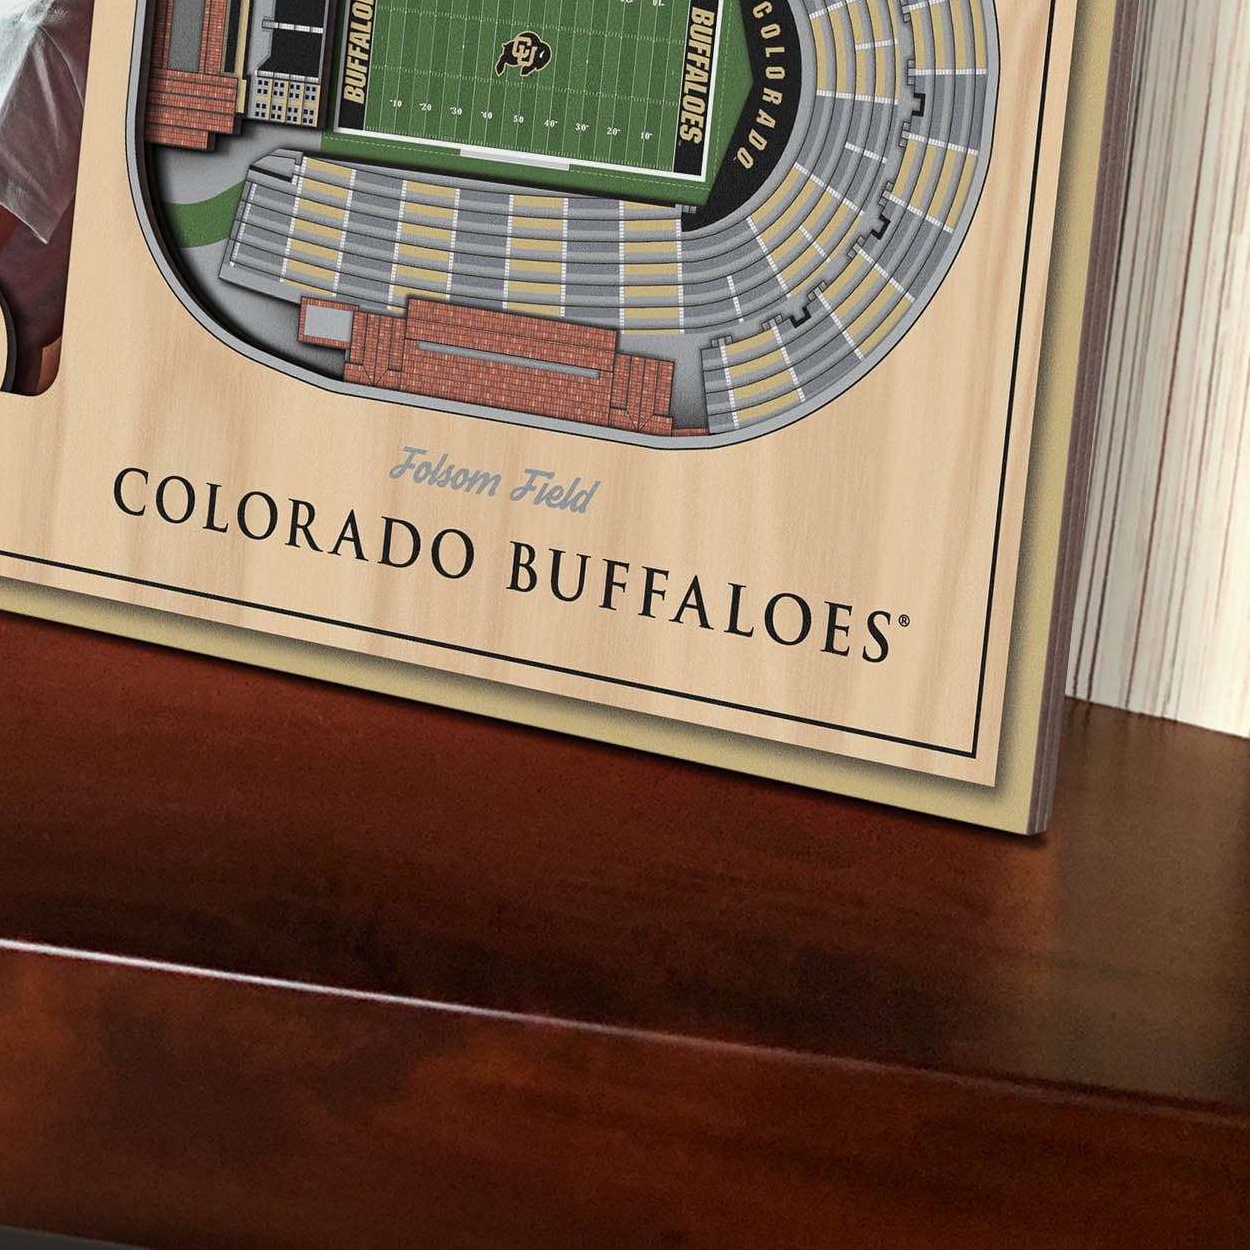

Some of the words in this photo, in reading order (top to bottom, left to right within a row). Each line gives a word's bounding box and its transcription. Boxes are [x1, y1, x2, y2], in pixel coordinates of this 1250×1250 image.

[679, 6, 715, 144] BUFFALOES
[736, 0, 786, 170] COLORADO
[113, 466, 476, 580] COLORADO
[388, 446, 502, 498] Folsom
[508, 467, 602, 515] Field
